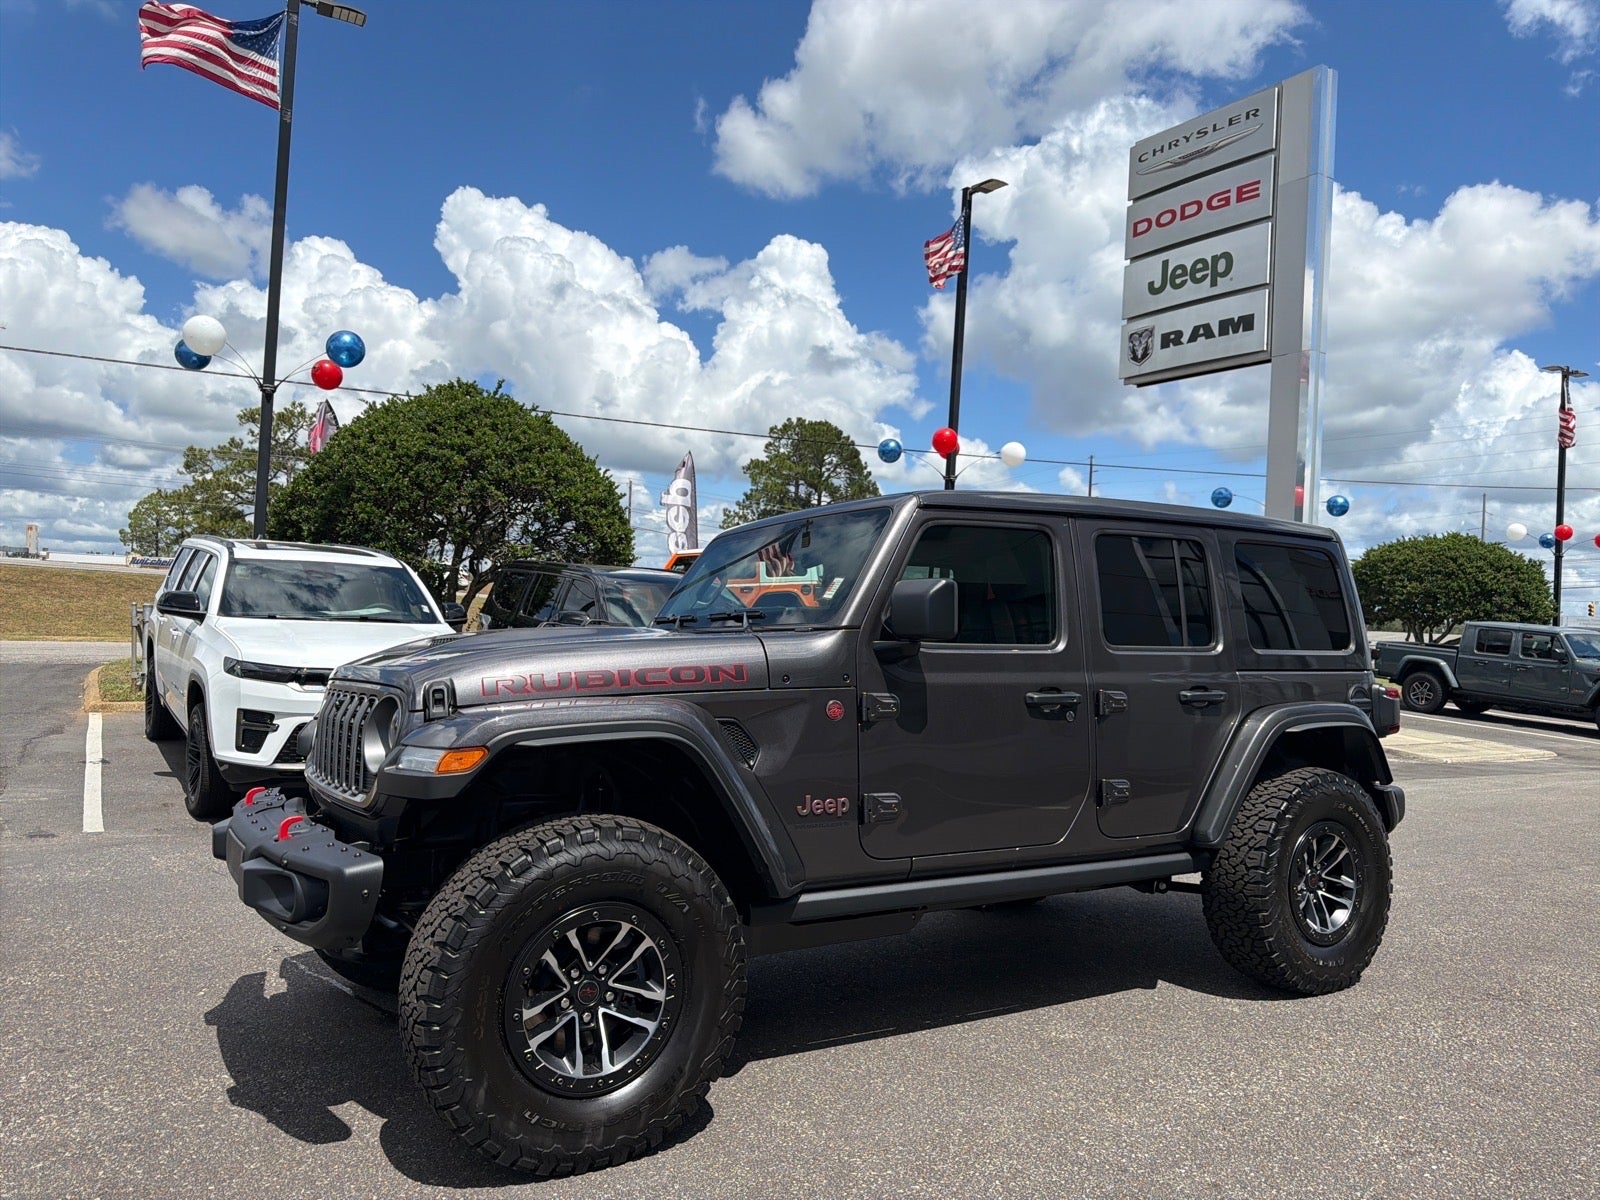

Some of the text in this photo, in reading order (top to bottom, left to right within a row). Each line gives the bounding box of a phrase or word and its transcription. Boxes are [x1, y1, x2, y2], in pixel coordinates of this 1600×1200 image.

[1137, 107, 1261, 163] CHRYSLER
[1132, 179, 1261, 238] DODGE
[1147, 251, 1234, 296] Jeep
[1160, 313, 1255, 350] RAM
[481, 663, 749, 697] RUBICON
[796, 794, 850, 818] Jeep
